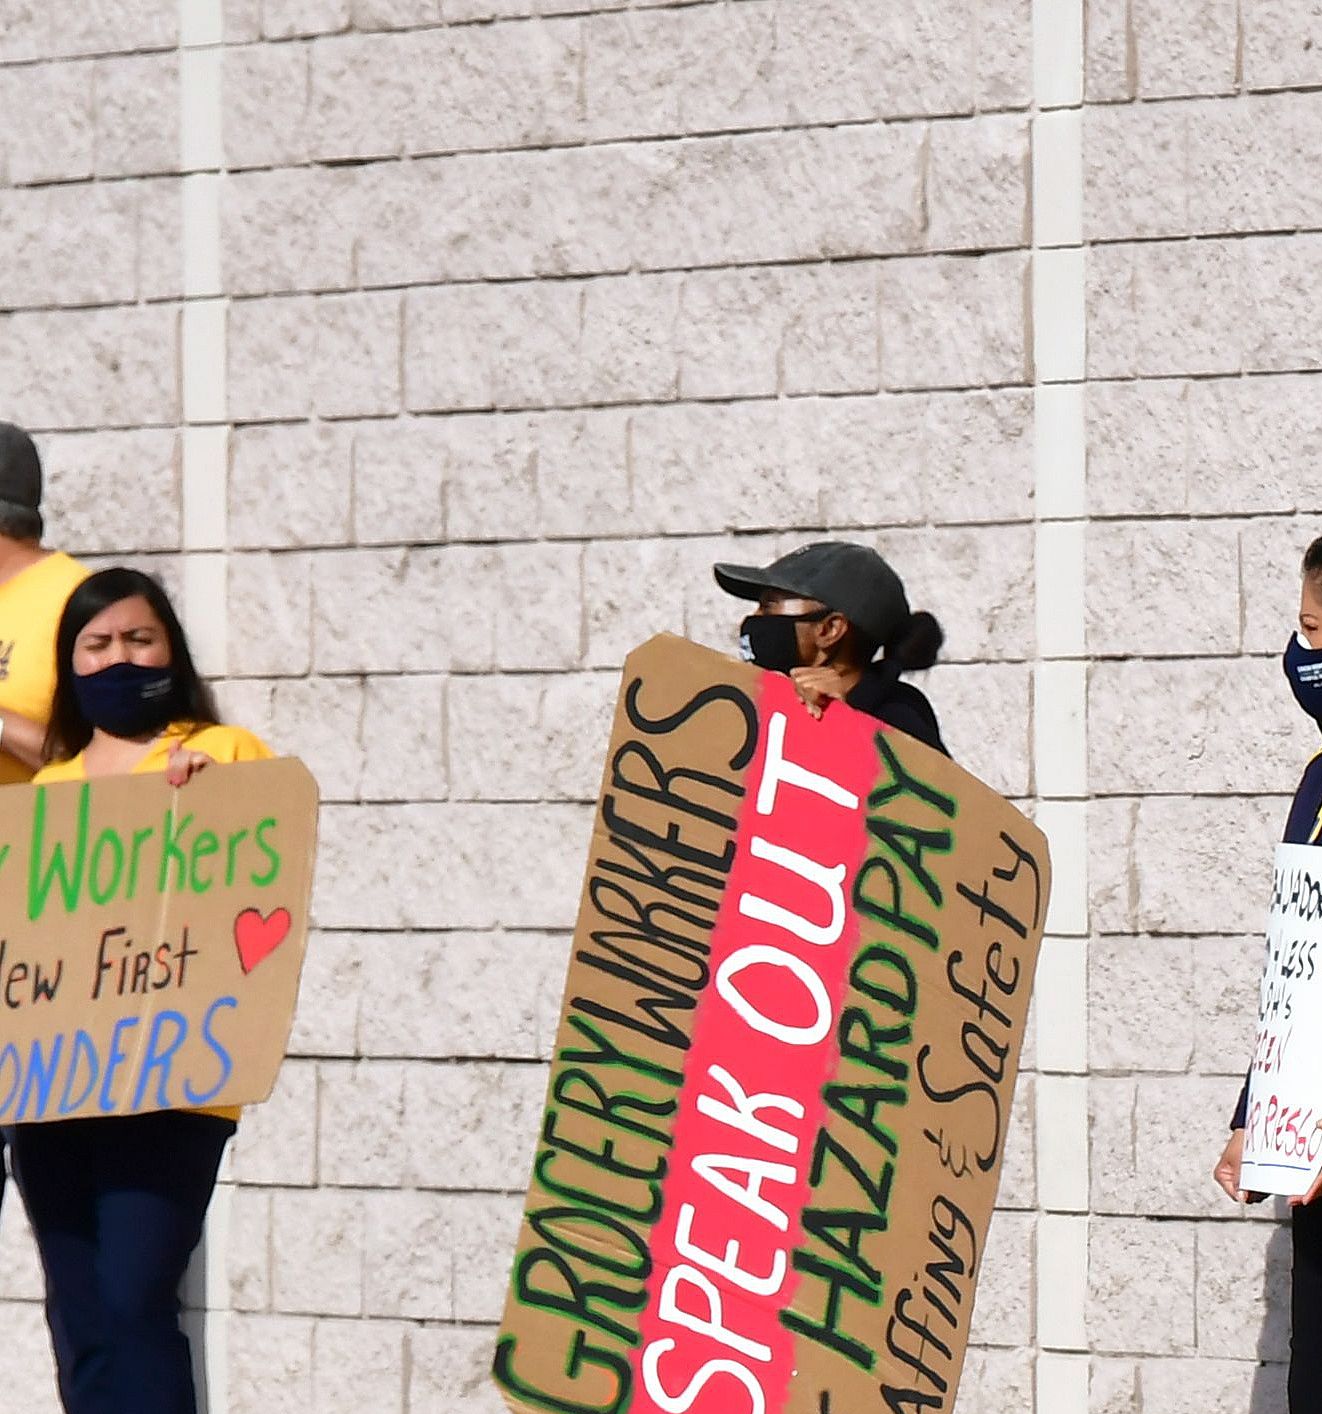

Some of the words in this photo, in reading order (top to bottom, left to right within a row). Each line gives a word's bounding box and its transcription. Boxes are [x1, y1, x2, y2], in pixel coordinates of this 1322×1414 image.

[0, 939, 63, 1010] ew
[28, 781, 281, 922] Workers
[570, 677, 759, 1051] WORKERS
[715, 712, 859, 1045] OUT
[916, 830, 1041, 1172] Safety
[779, 943, 918, 1371] HAZARD
[852, 729, 958, 951] PAY
